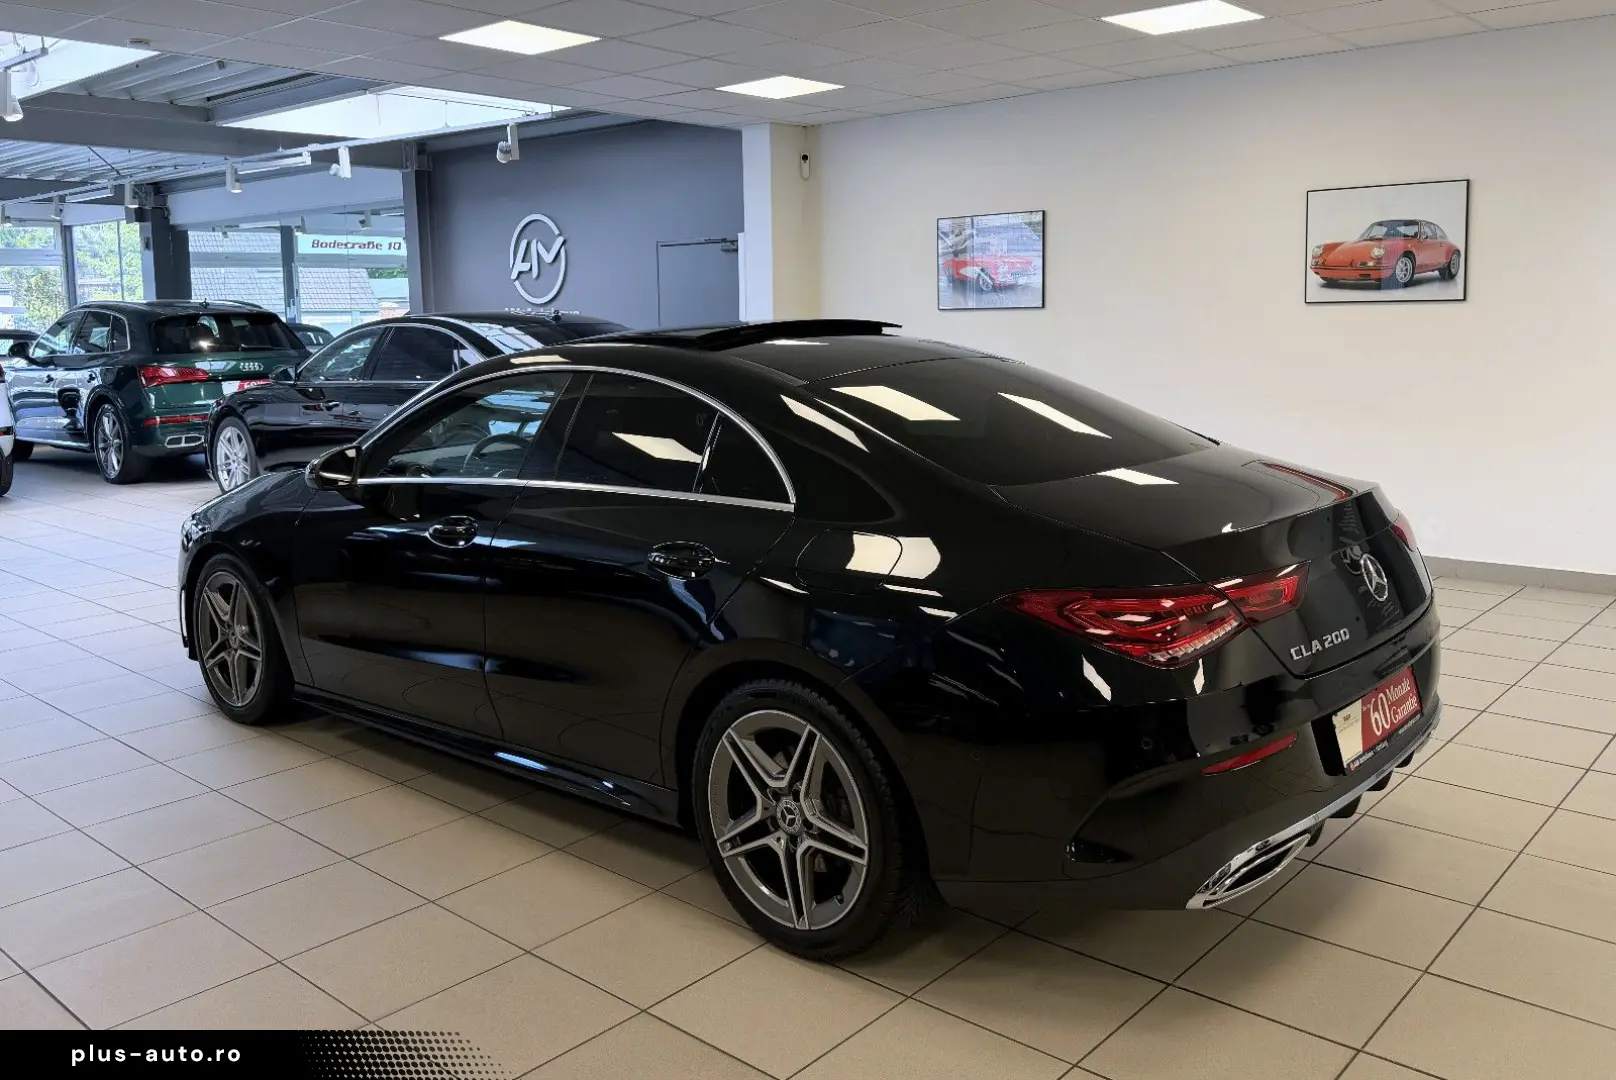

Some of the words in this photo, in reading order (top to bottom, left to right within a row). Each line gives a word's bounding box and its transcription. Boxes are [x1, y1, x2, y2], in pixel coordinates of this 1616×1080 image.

[387, 241, 402, 251] 10
[1290, 639, 1323, 661] CLA
[1322, 627, 1350, 649] 200
[1370, 692, 1391, 736] 60
[1385, 677, 1411, 705] Monate
[1390, 693, 1418, 724] Garantie
